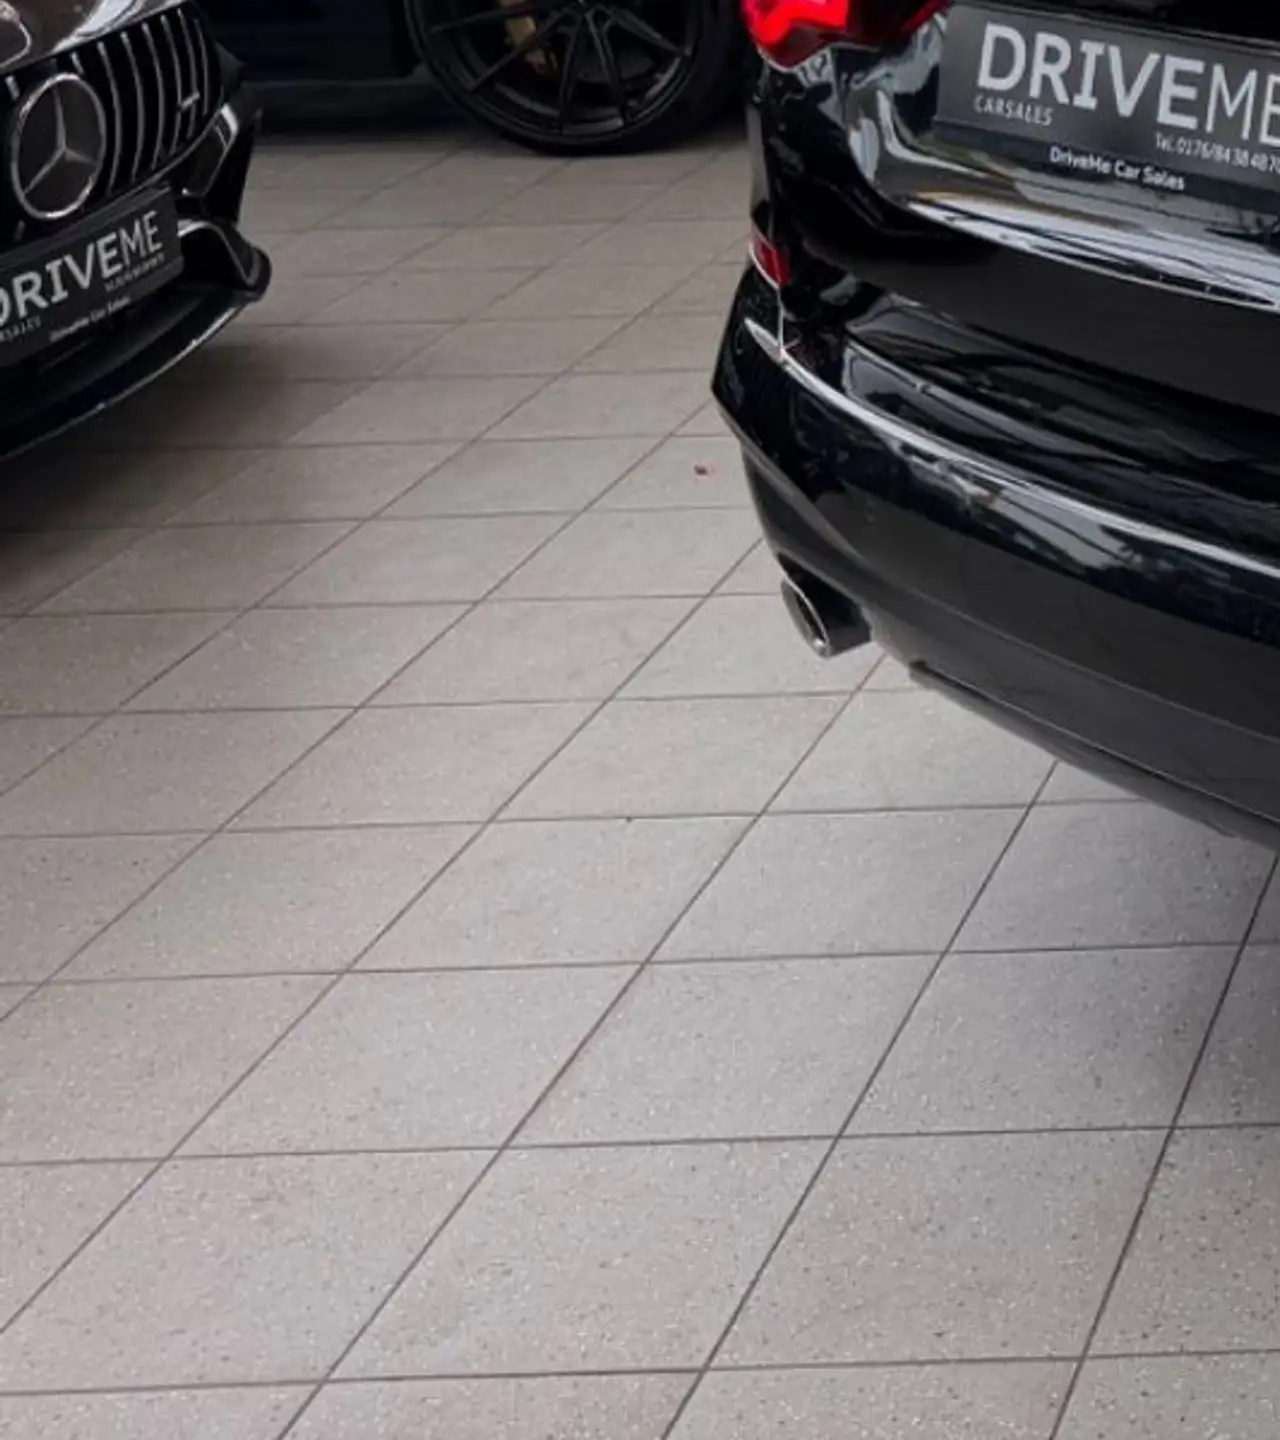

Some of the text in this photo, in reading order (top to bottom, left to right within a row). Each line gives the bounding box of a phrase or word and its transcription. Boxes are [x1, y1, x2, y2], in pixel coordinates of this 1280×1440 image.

[973, 94, 1054, 127] CARSALES
[1050, 145, 1112, 175] DriveMe
[1113, 159, 1142, 180] Car
